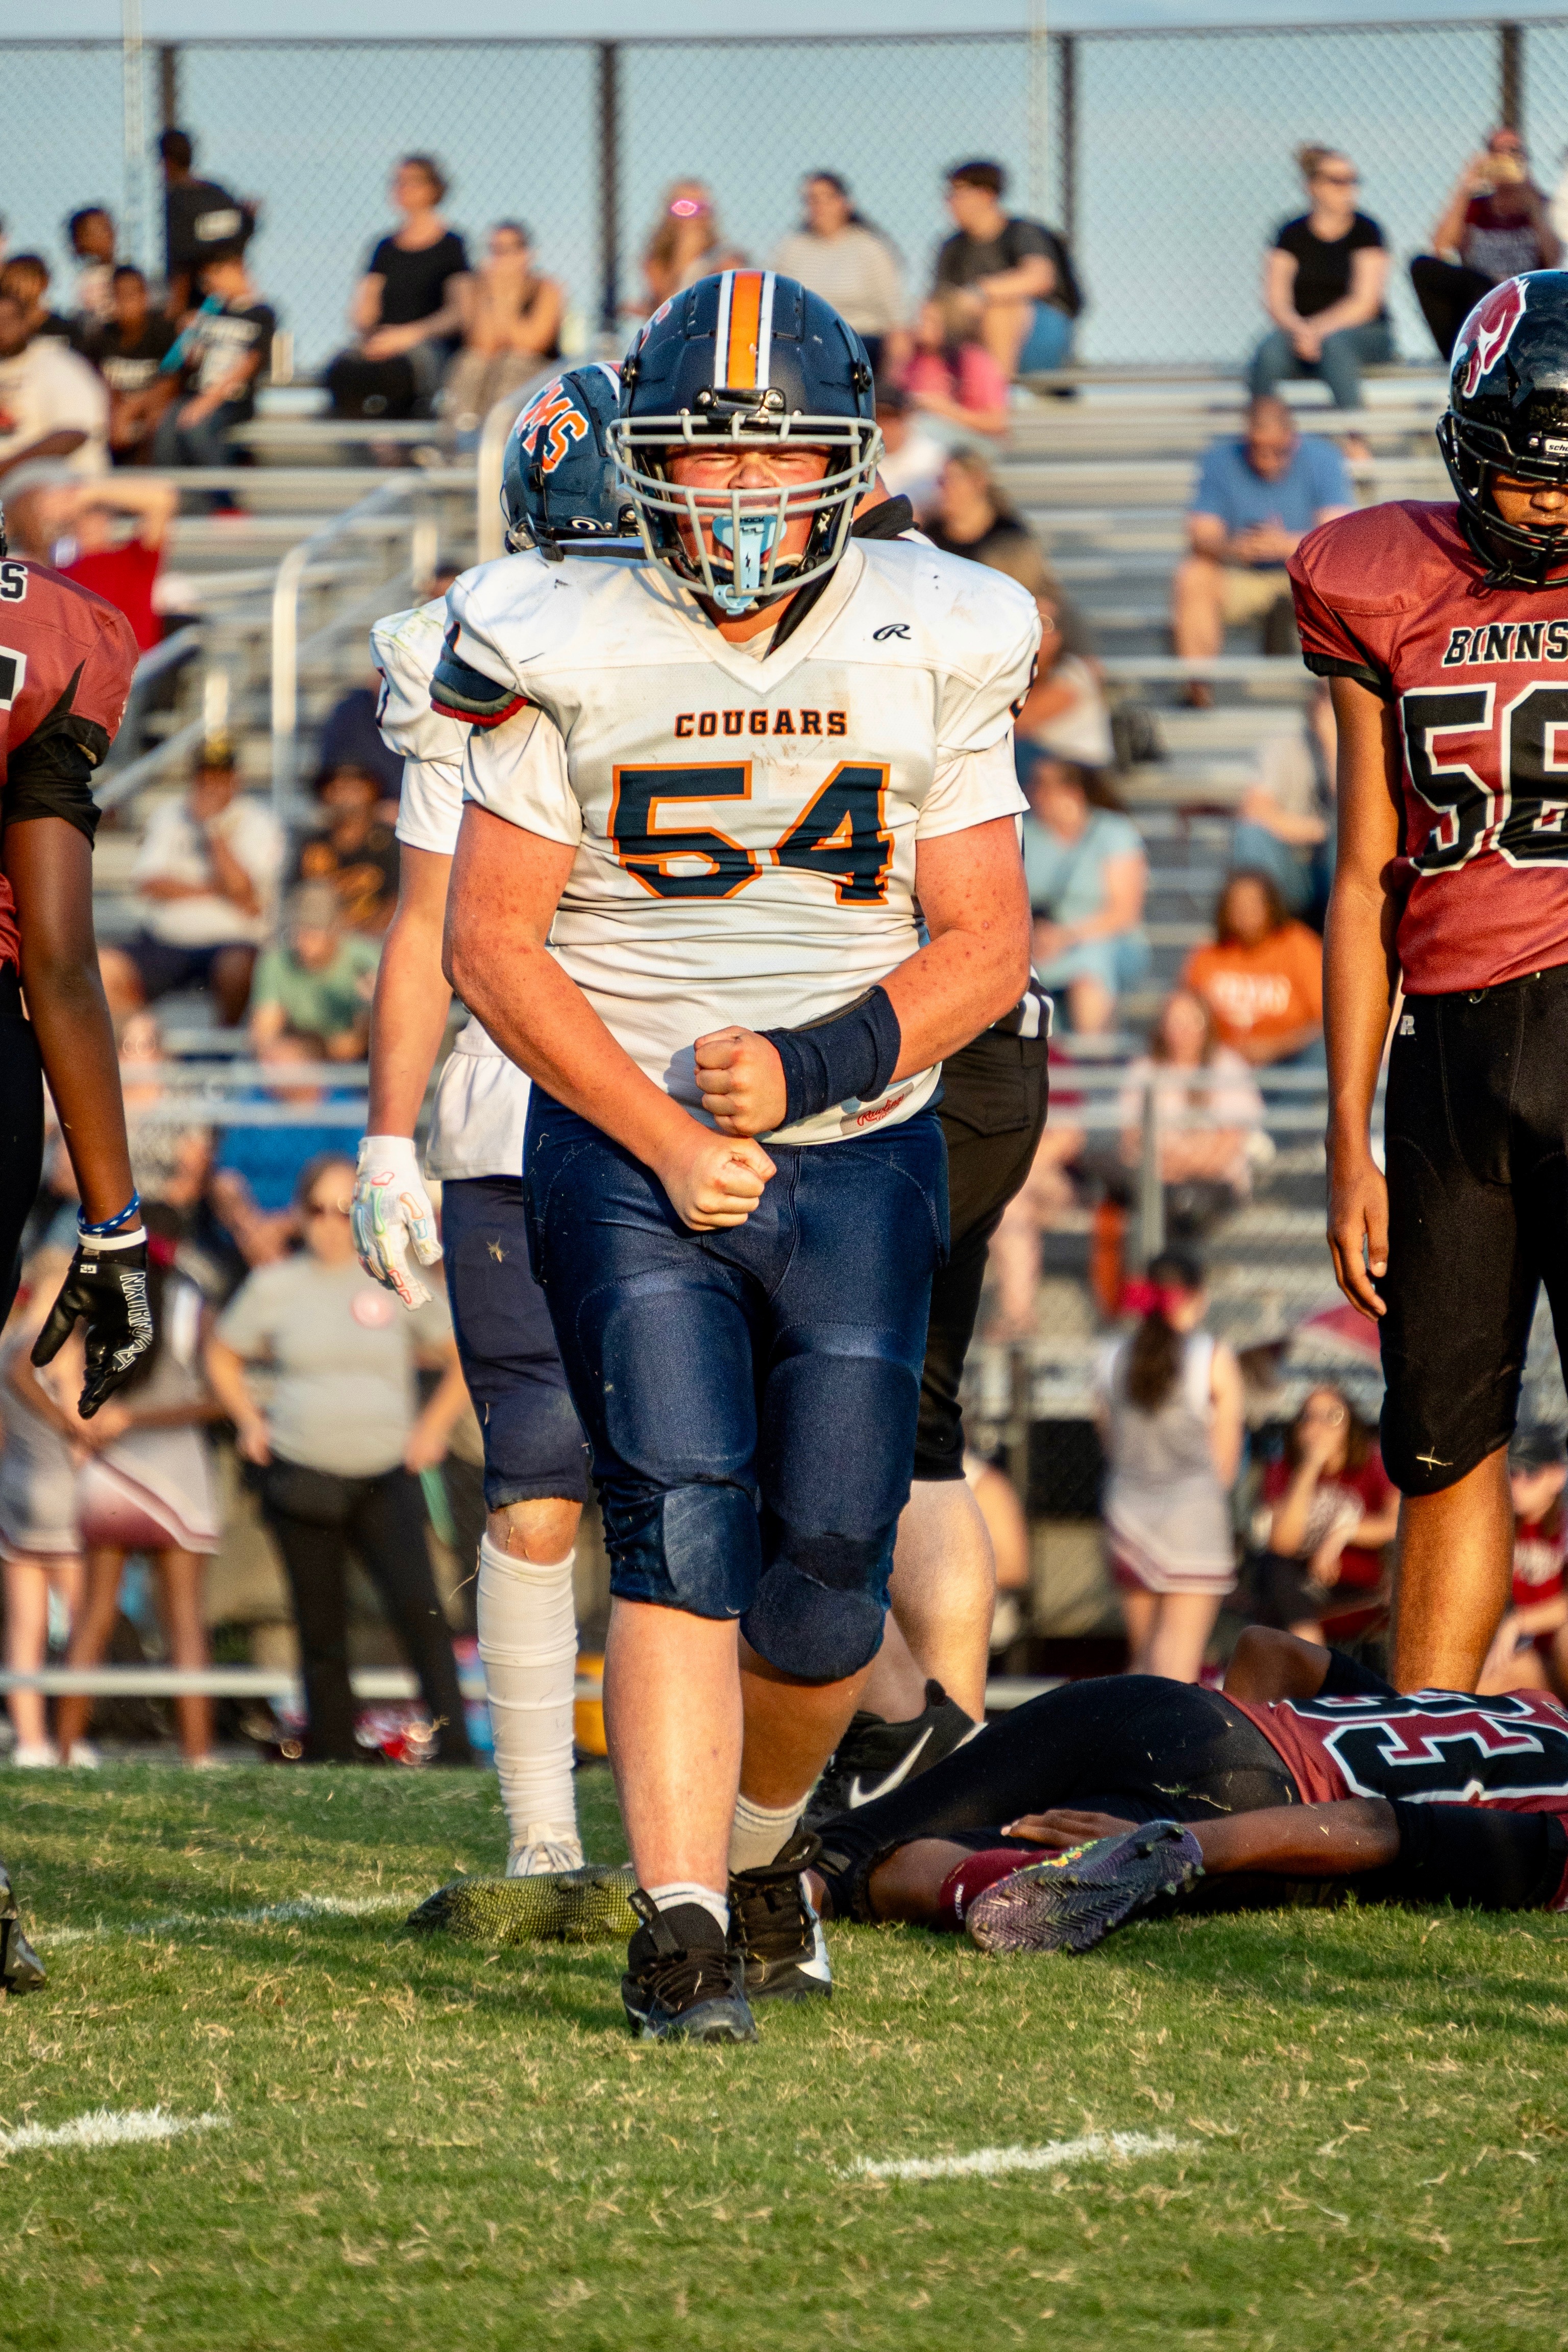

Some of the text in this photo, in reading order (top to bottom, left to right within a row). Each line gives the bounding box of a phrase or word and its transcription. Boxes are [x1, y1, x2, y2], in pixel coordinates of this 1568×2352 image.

[517, 376, 589, 473] MS
[1441, 621, 1568, 668] BINNS
[674, 708, 848, 739] COUGARS
[606, 760, 895, 906] 54
